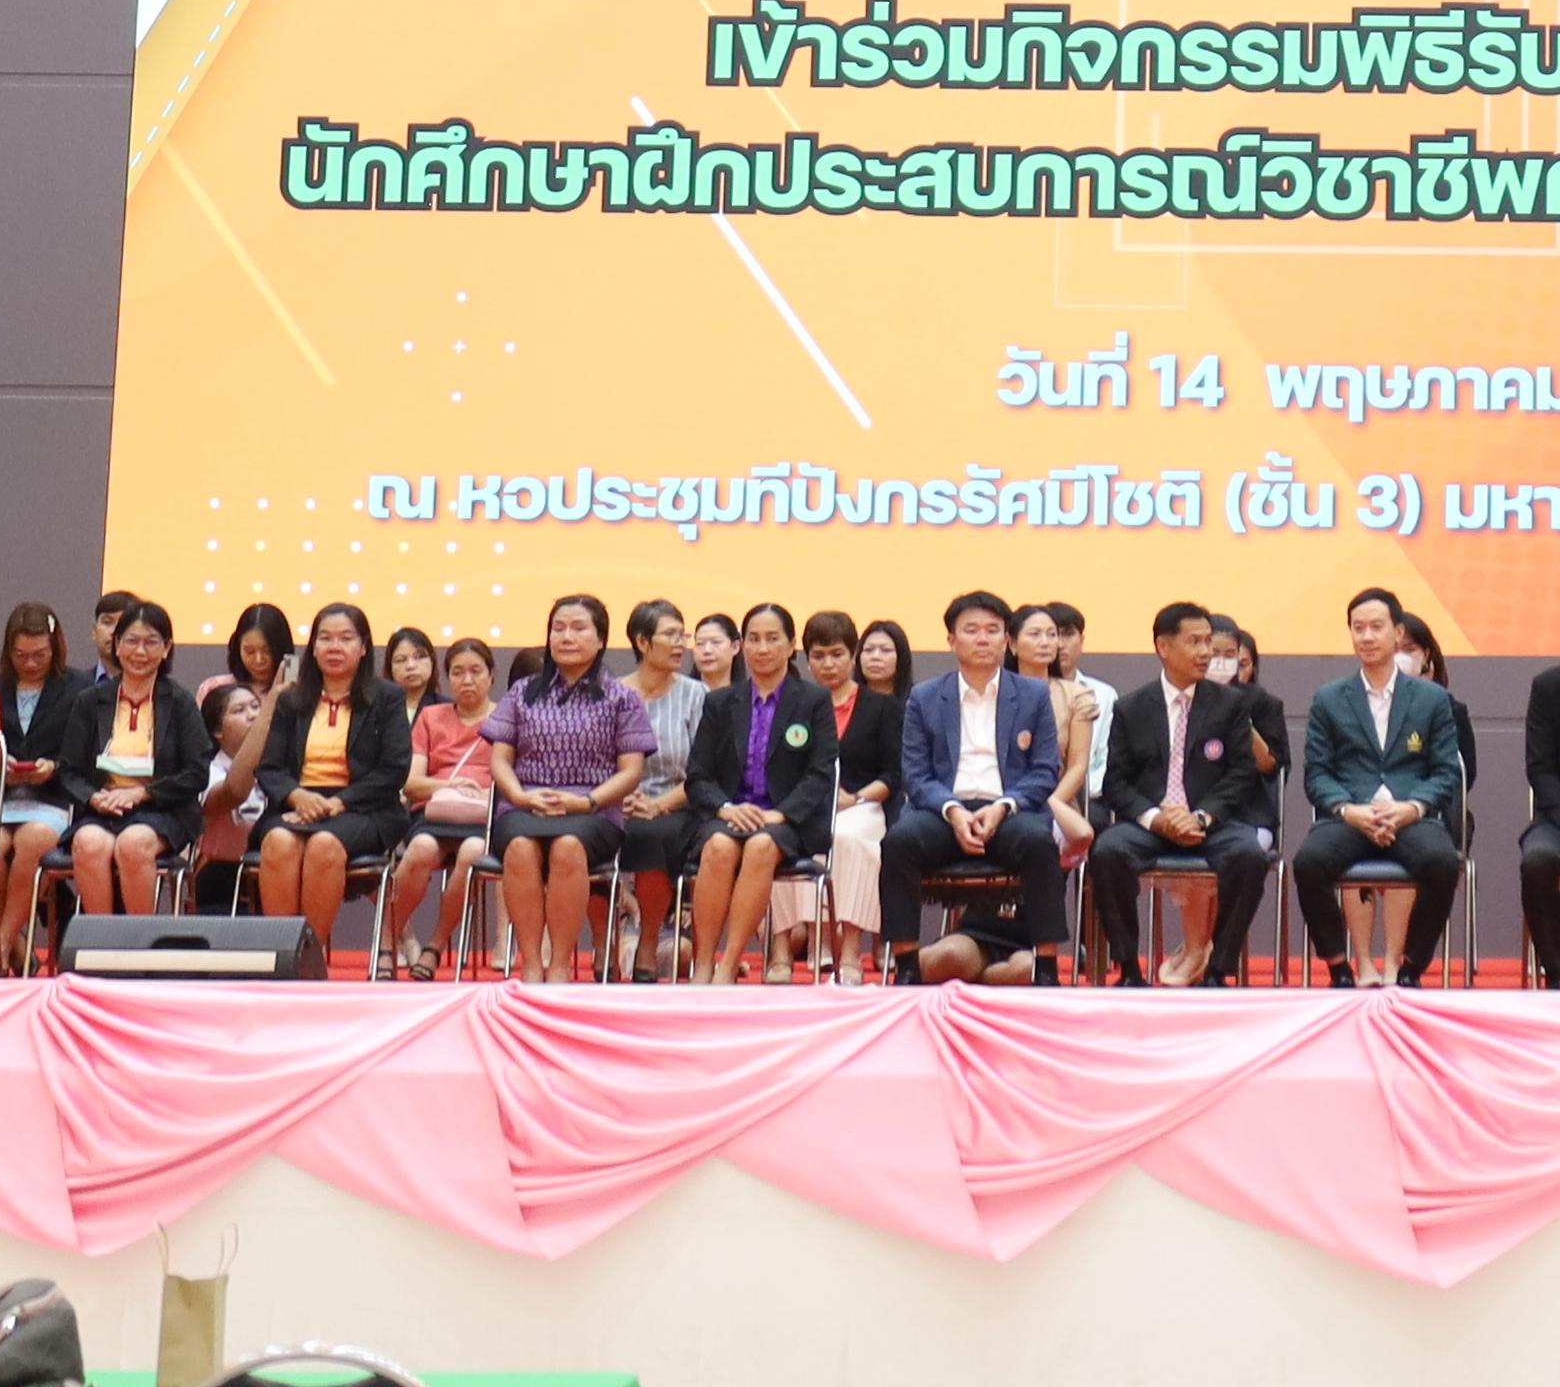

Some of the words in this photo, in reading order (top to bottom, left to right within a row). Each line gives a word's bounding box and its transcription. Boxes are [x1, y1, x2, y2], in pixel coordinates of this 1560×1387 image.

[996, 331, 1130, 409] วันที่
[1149, 354, 1225, 410] 14
[367, 473, 436, 520] ณ
[457, 461, 1202, 542] หอประชุมทีปังกรรัศมีโชติ
[1225, 451, 1334, 534] (ชั้น
[1356, 475, 1422, 535] 3)
